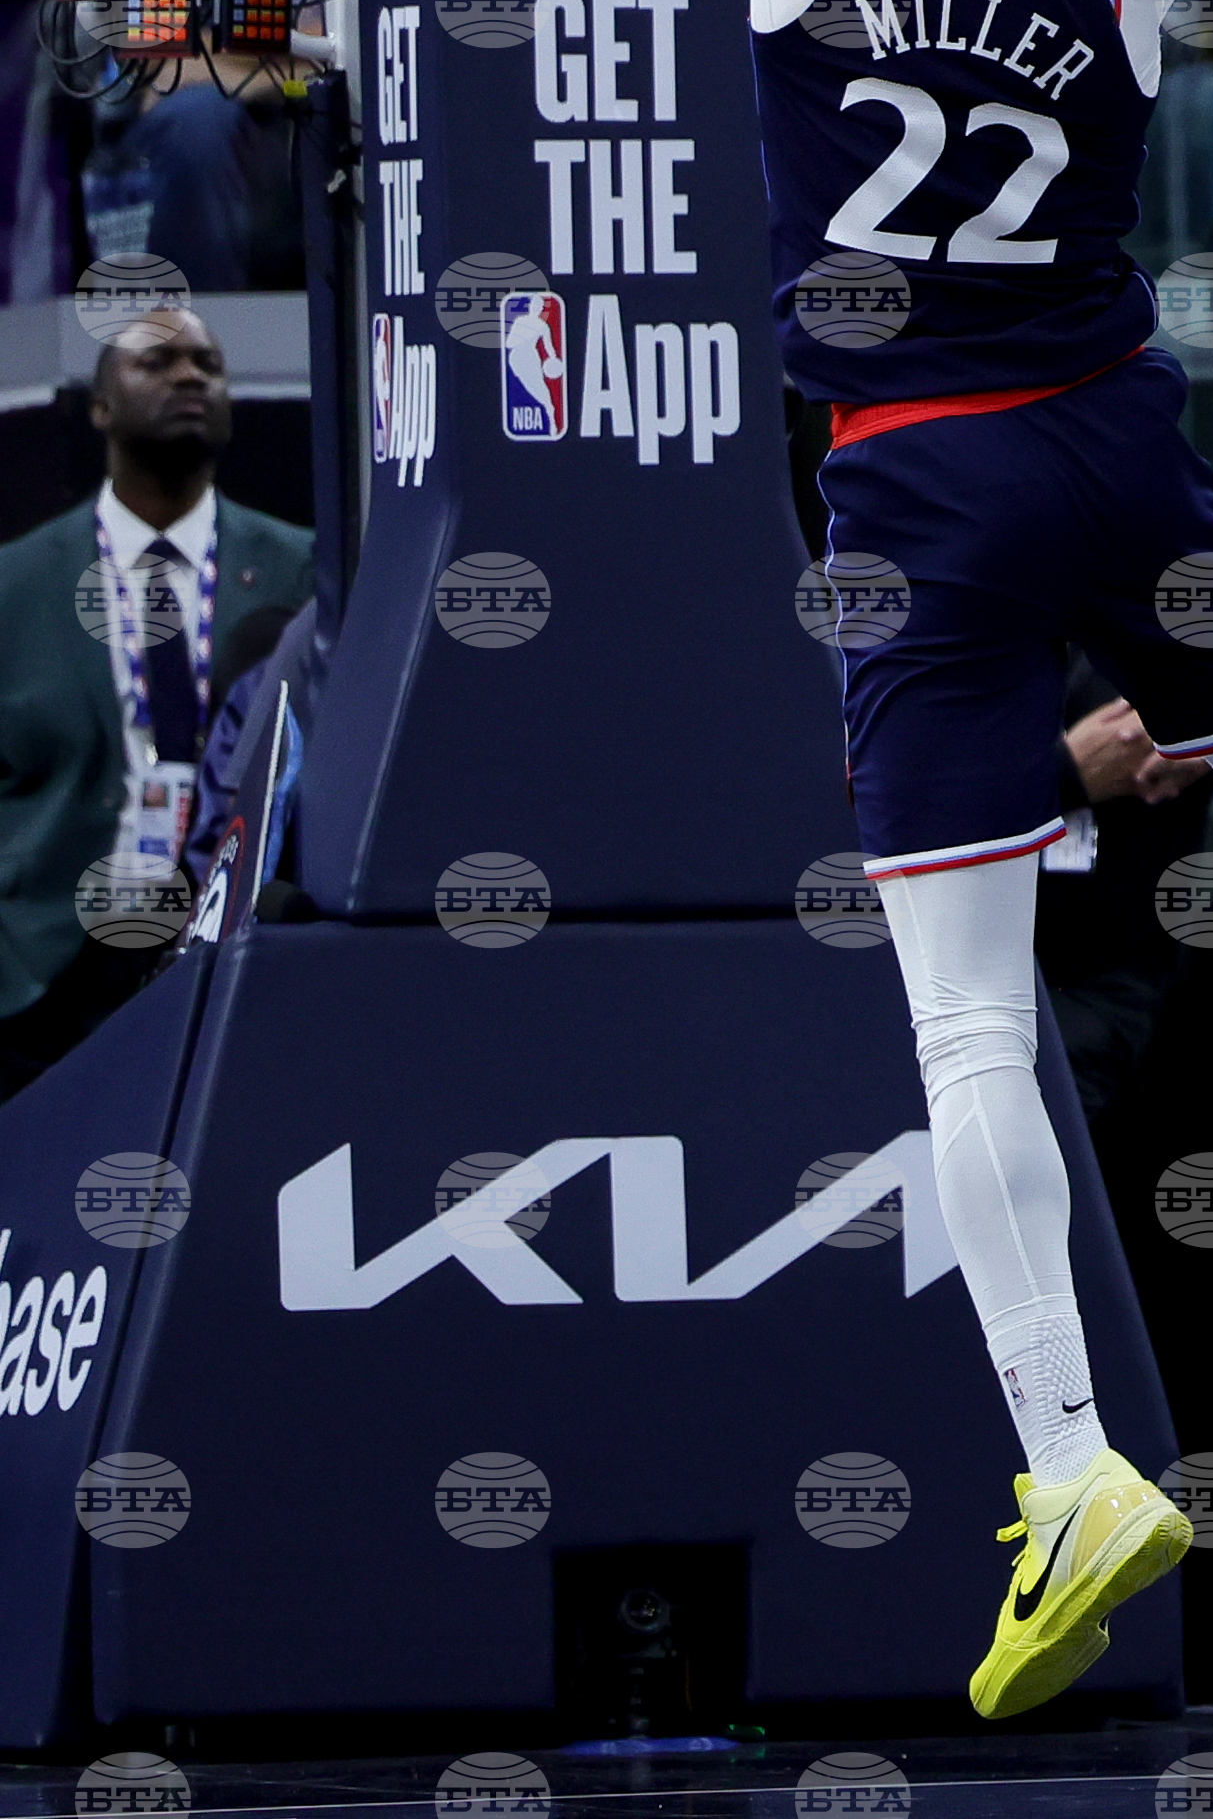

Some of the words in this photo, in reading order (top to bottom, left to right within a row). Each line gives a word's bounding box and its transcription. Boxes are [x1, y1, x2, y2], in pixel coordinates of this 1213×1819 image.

[378, 5, 420, 145] GET
[379, 159, 425, 296] THE
[534, 139, 697, 275] THE
[824, 77, 1069, 263] 22
[389, 315, 436, 487] App
[512, 406, 543, 432] NBA
[580, 294, 741, 465] App
